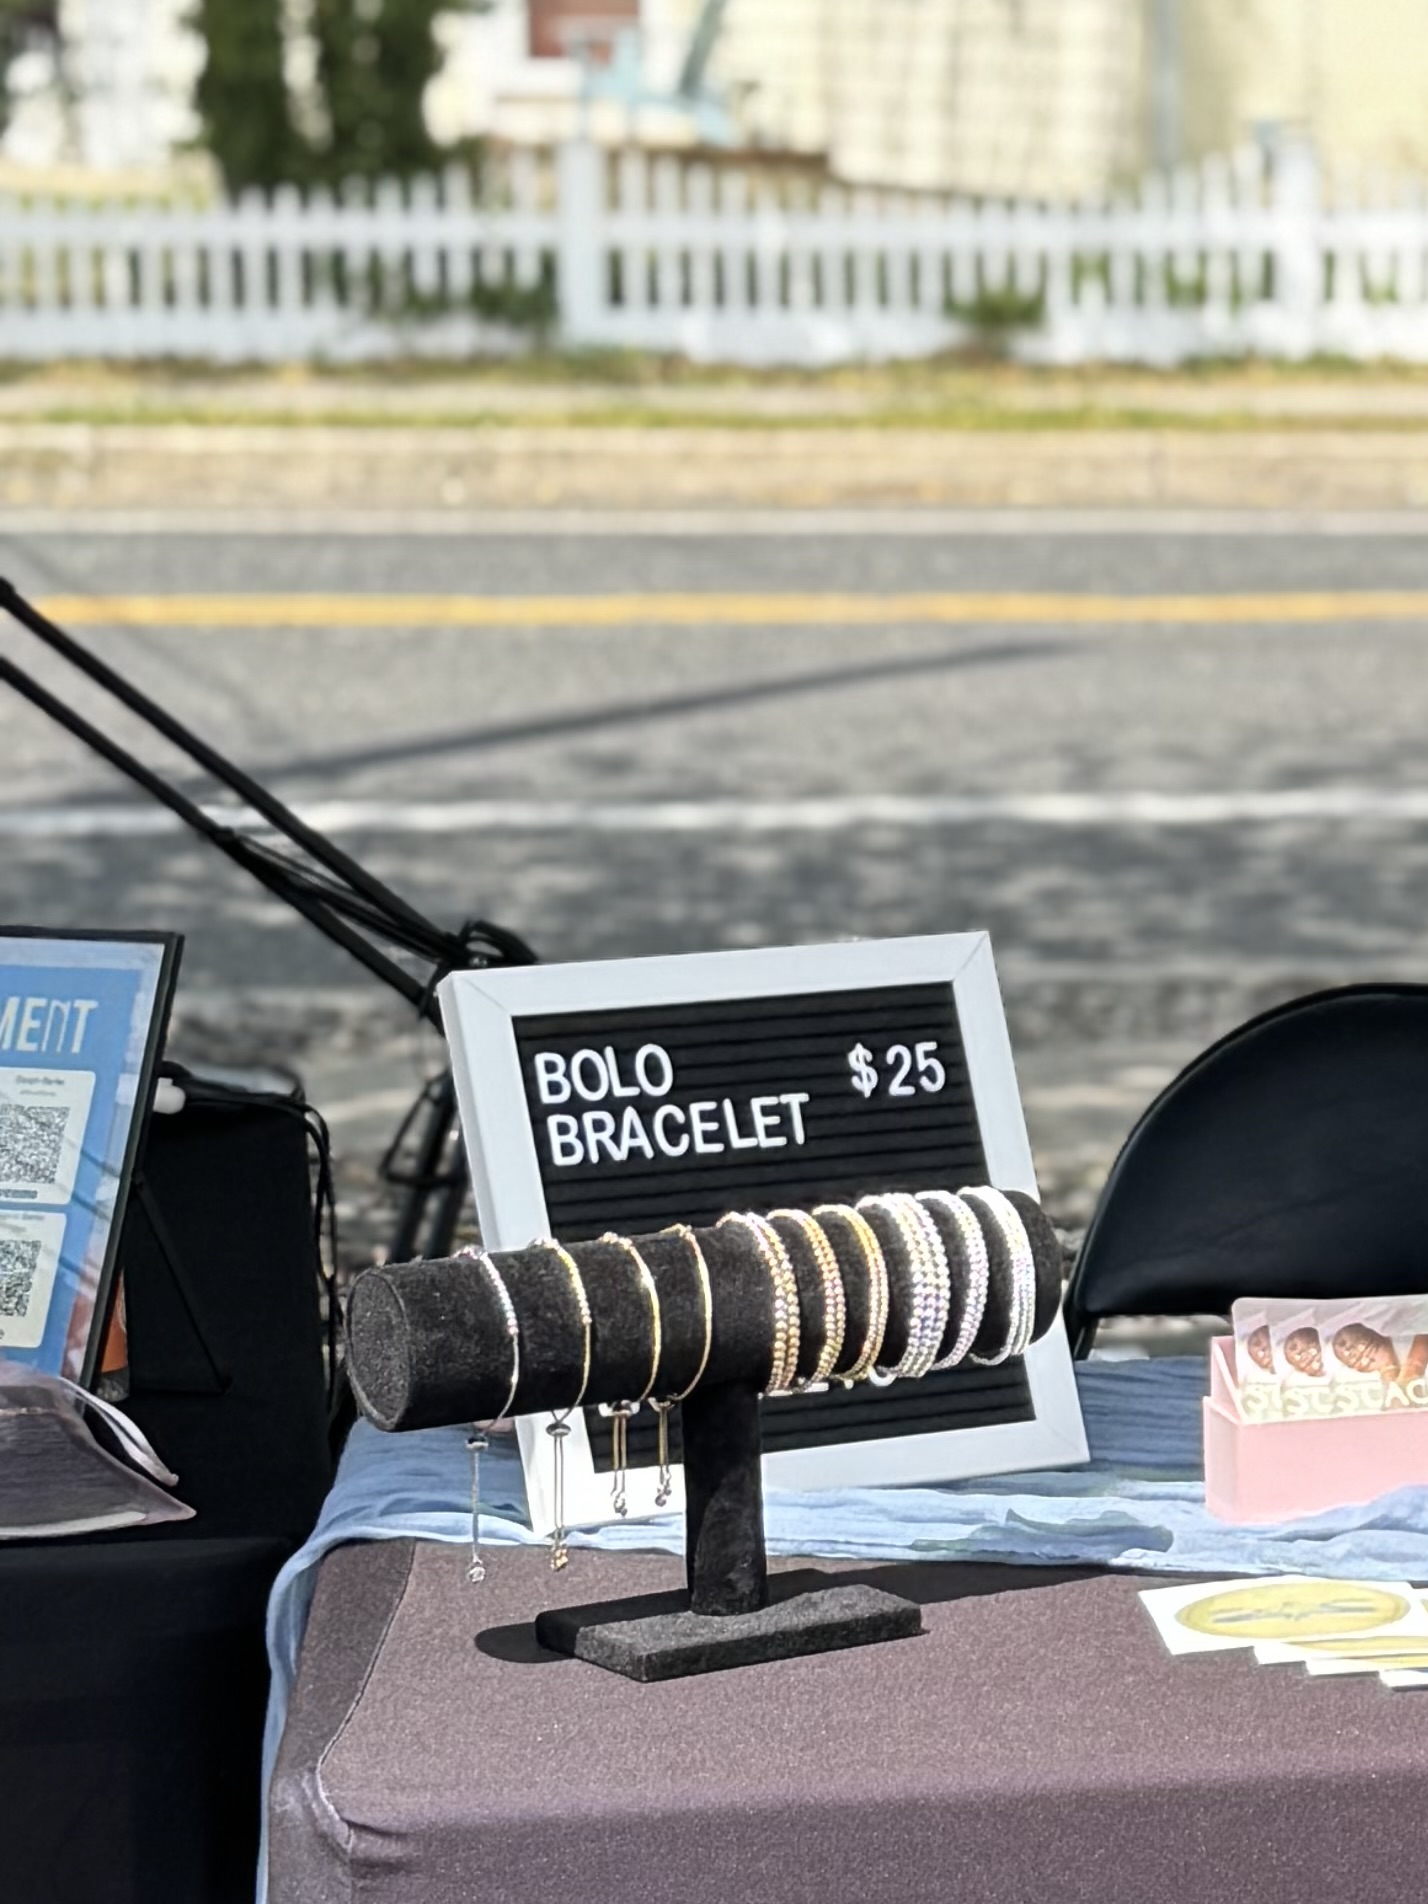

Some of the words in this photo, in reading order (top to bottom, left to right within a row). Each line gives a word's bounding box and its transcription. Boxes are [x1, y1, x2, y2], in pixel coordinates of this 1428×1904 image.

[534, 1043, 674, 1104] BOLO
[846, 1040, 947, 1098] $25
[546, 1092, 810, 1167] BRACELET
